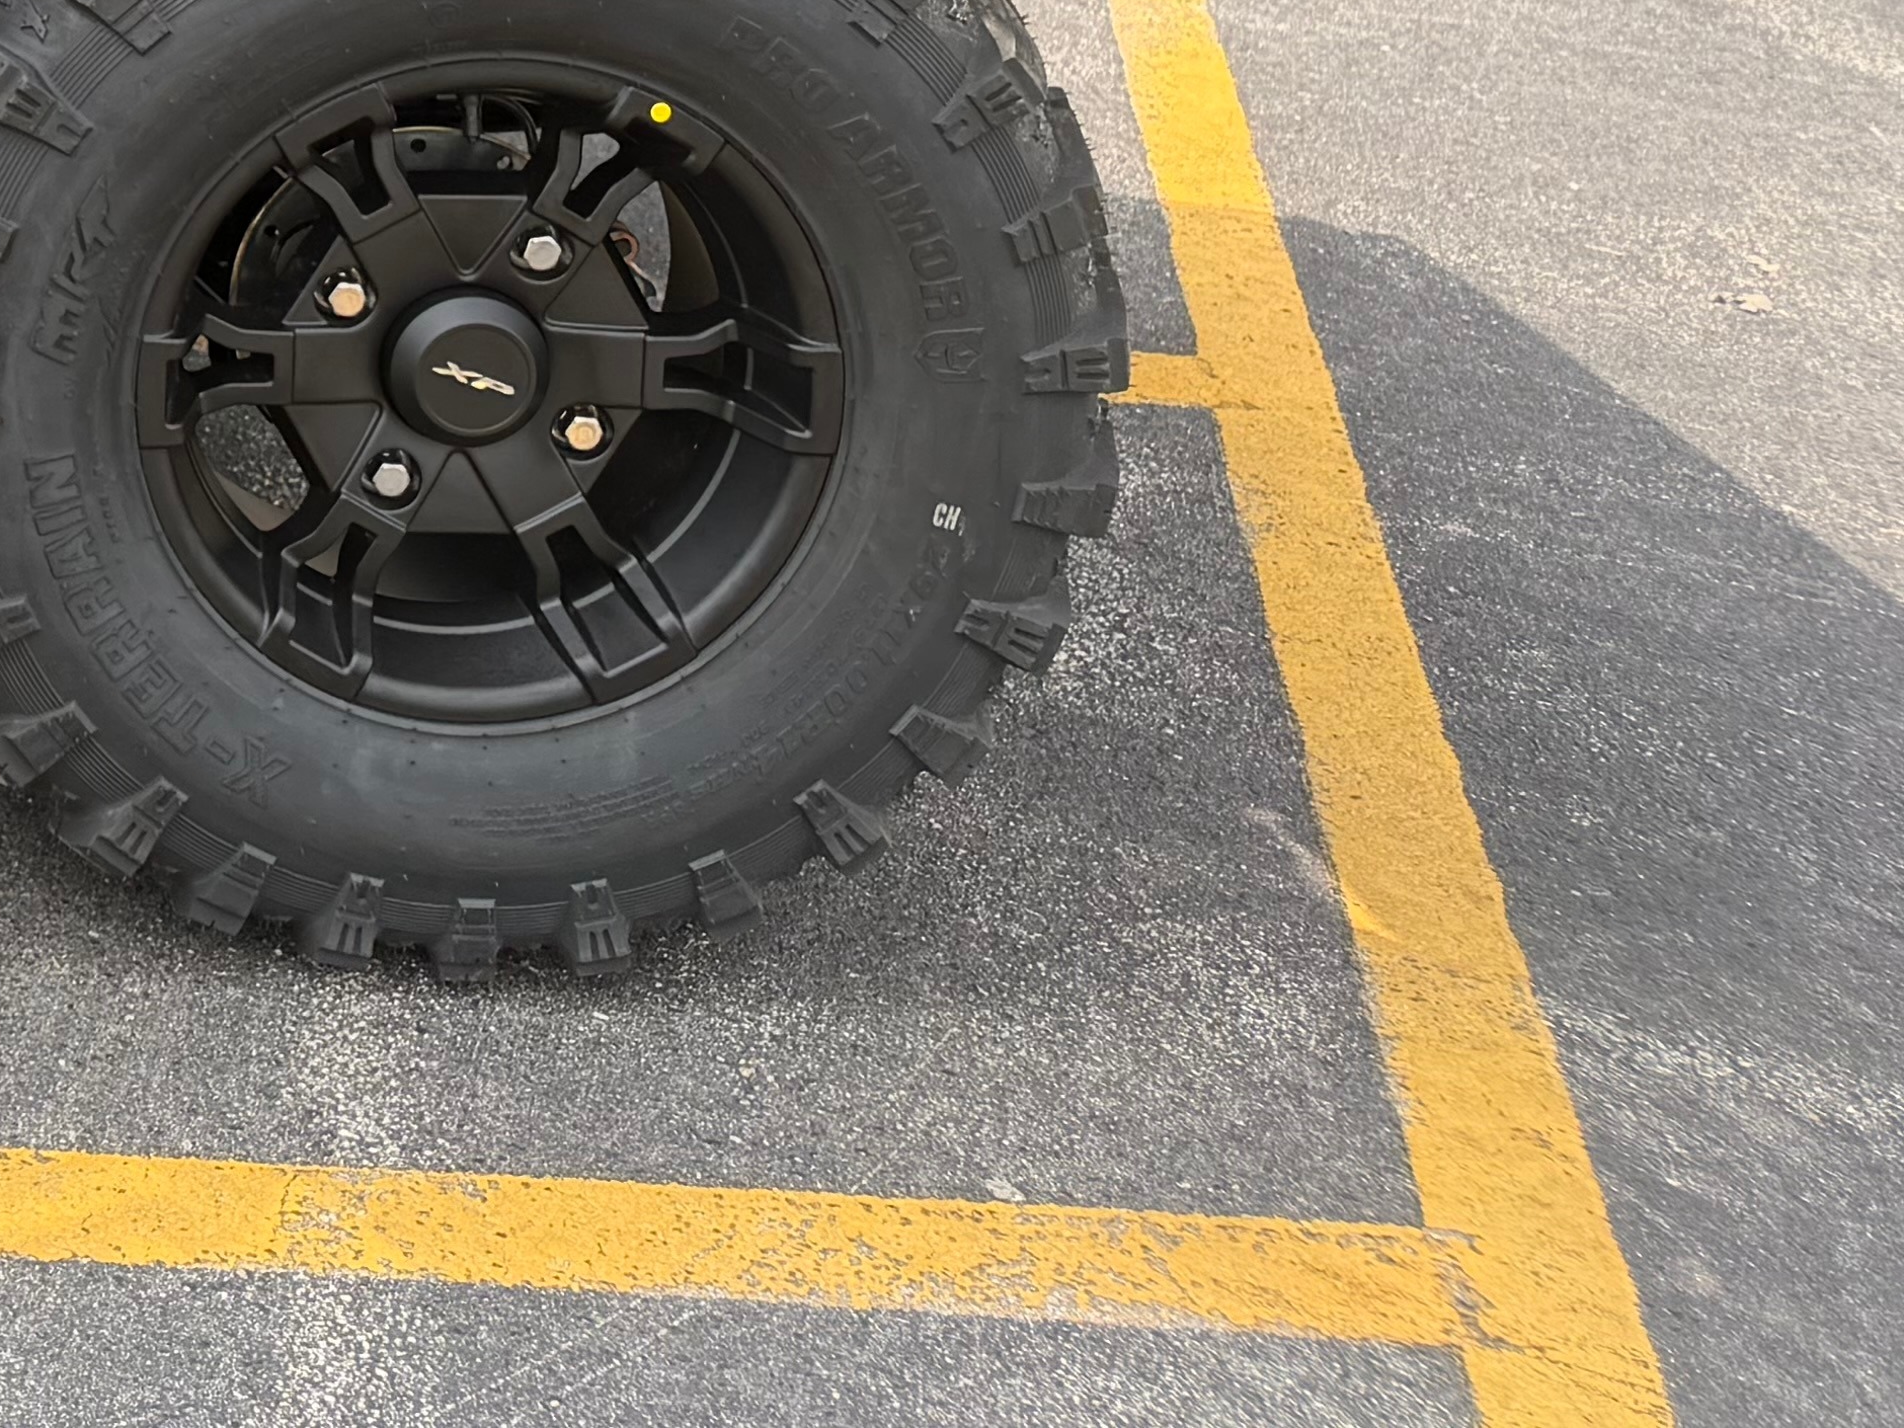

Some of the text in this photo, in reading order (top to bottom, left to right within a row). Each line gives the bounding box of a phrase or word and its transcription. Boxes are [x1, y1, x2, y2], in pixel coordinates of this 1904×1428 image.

[717, 14, 970, 322] PRO ARMOR
[431, 359, 516, 396] XP
[24, 450, 291, 809] X-TERRAIN
